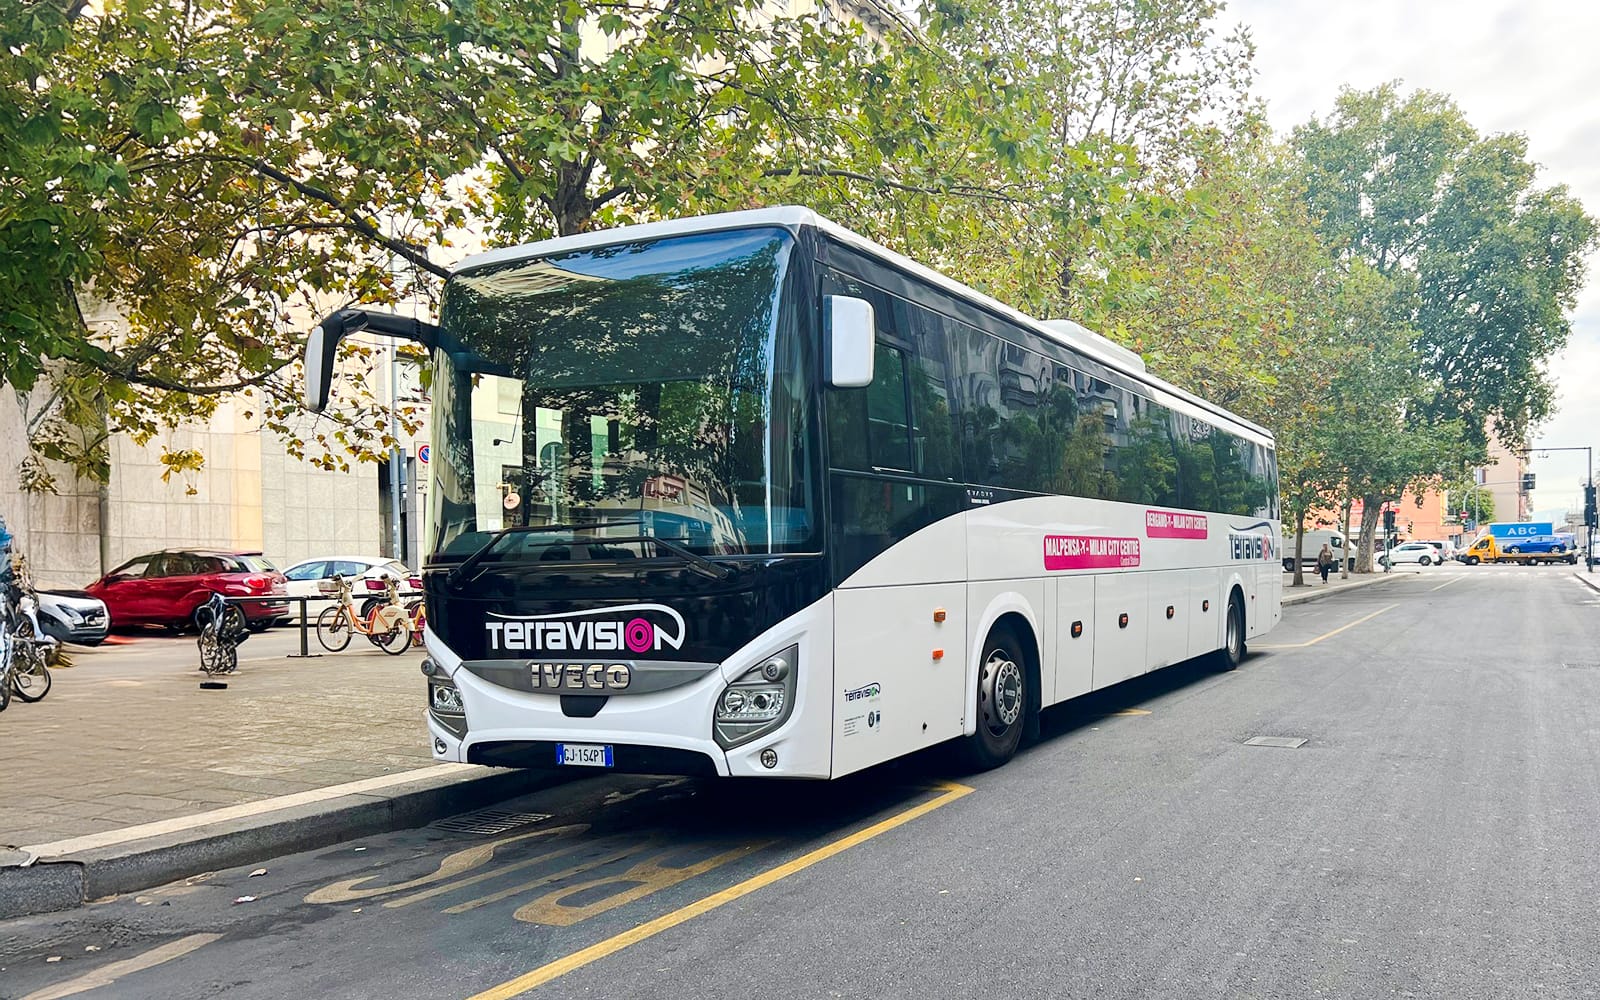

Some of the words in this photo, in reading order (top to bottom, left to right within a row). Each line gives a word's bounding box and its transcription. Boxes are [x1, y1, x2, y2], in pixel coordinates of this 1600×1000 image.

[1507, 527, 1537, 536] ABC
[1045, 538, 1080, 556] MALPENSA
[1089, 539, 1107, 555] MILAN
[1108, 540, 1119, 555] CITY
[1120, 540, 1139, 555] CENTRE
[530, 663, 632, 689] IVECO
